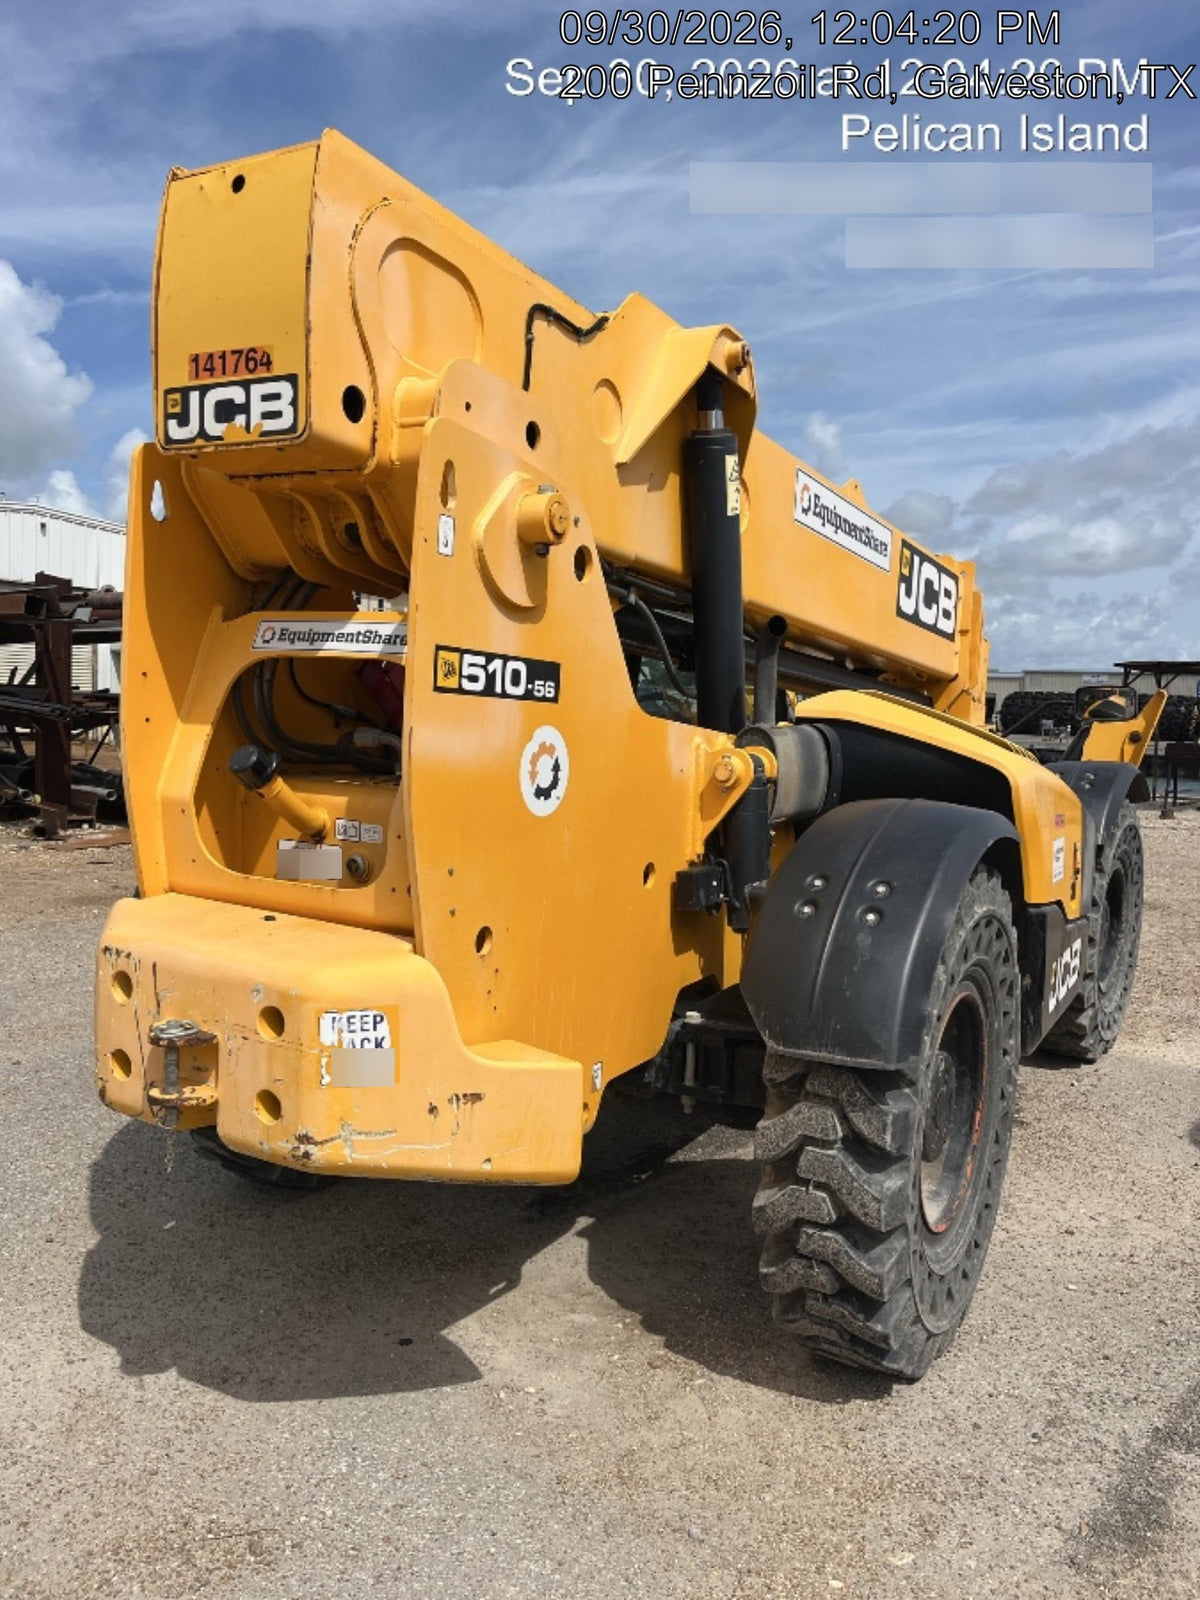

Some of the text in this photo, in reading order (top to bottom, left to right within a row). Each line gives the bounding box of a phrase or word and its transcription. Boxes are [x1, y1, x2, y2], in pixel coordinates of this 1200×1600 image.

[191, 347, 272, 379] 141764
[167, 380, 294, 440] JCB
[812, 492, 888, 558] EquipmentShare
[900, 554, 958, 634] JCB
[1049, 937, 1082, 1013] JCB
